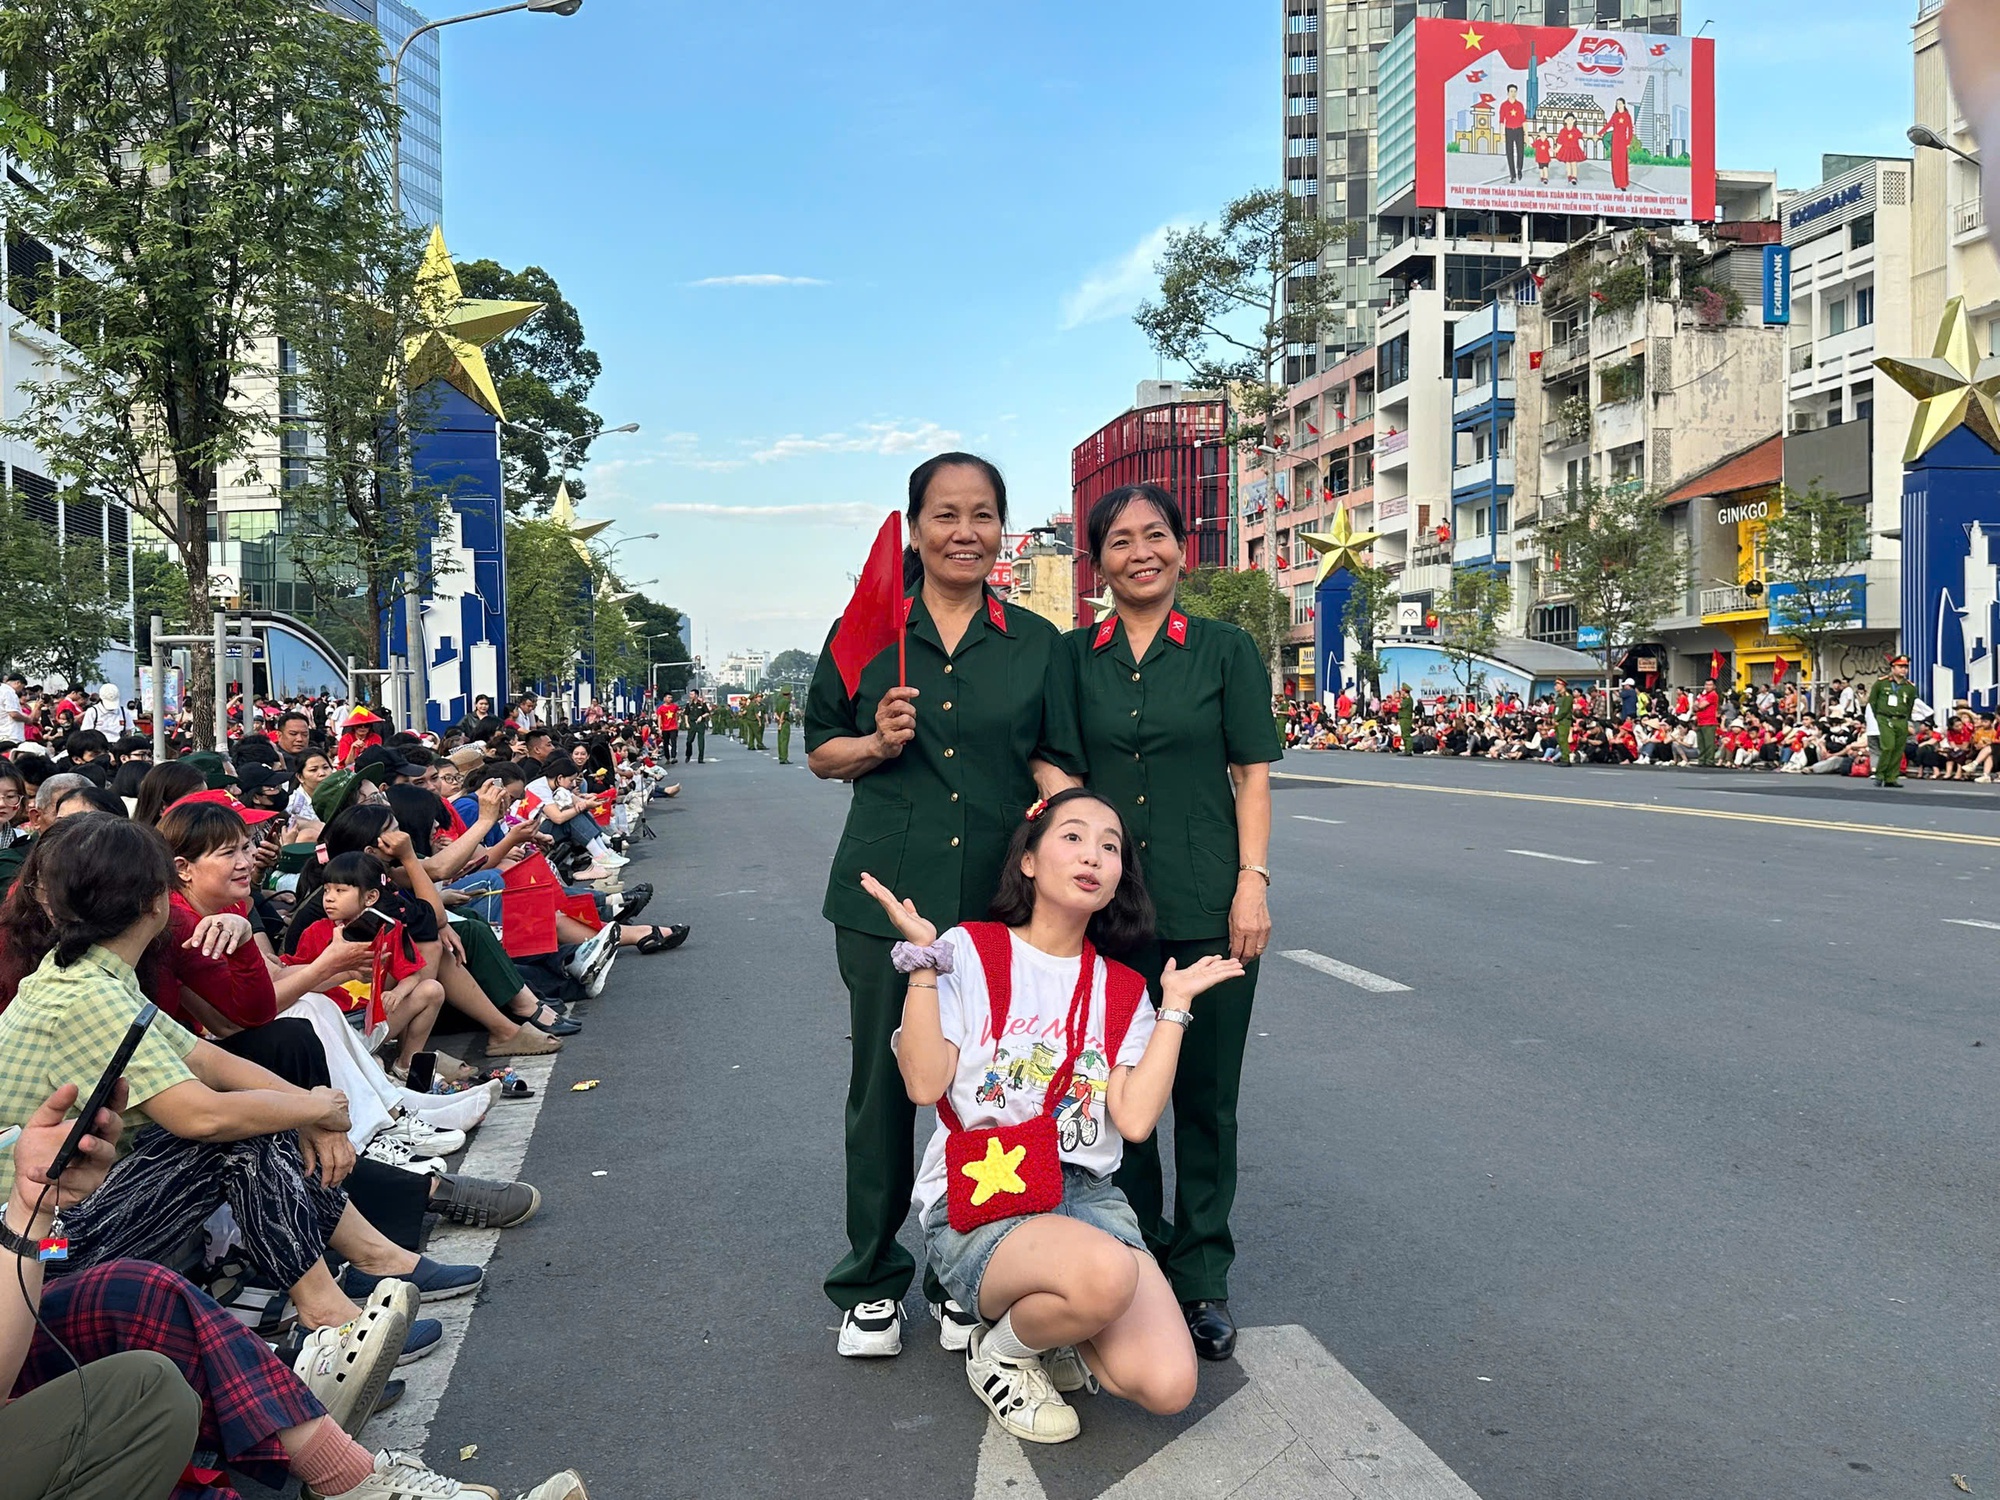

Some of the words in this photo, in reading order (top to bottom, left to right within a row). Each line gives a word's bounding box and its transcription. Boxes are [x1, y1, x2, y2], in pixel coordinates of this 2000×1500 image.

[1450, 186, 1465, 194] PHÁT
[1466, 187, 1477, 195] HUY
[1478, 187, 1491, 195] TINH
[1789, 182, 1864, 229] EXIMBANK
[1773, 253, 1783, 316] EXIMBANK
[1717, 501, 1768, 525] GINKGO
[980, 1014, 1040, 1047] Viet
